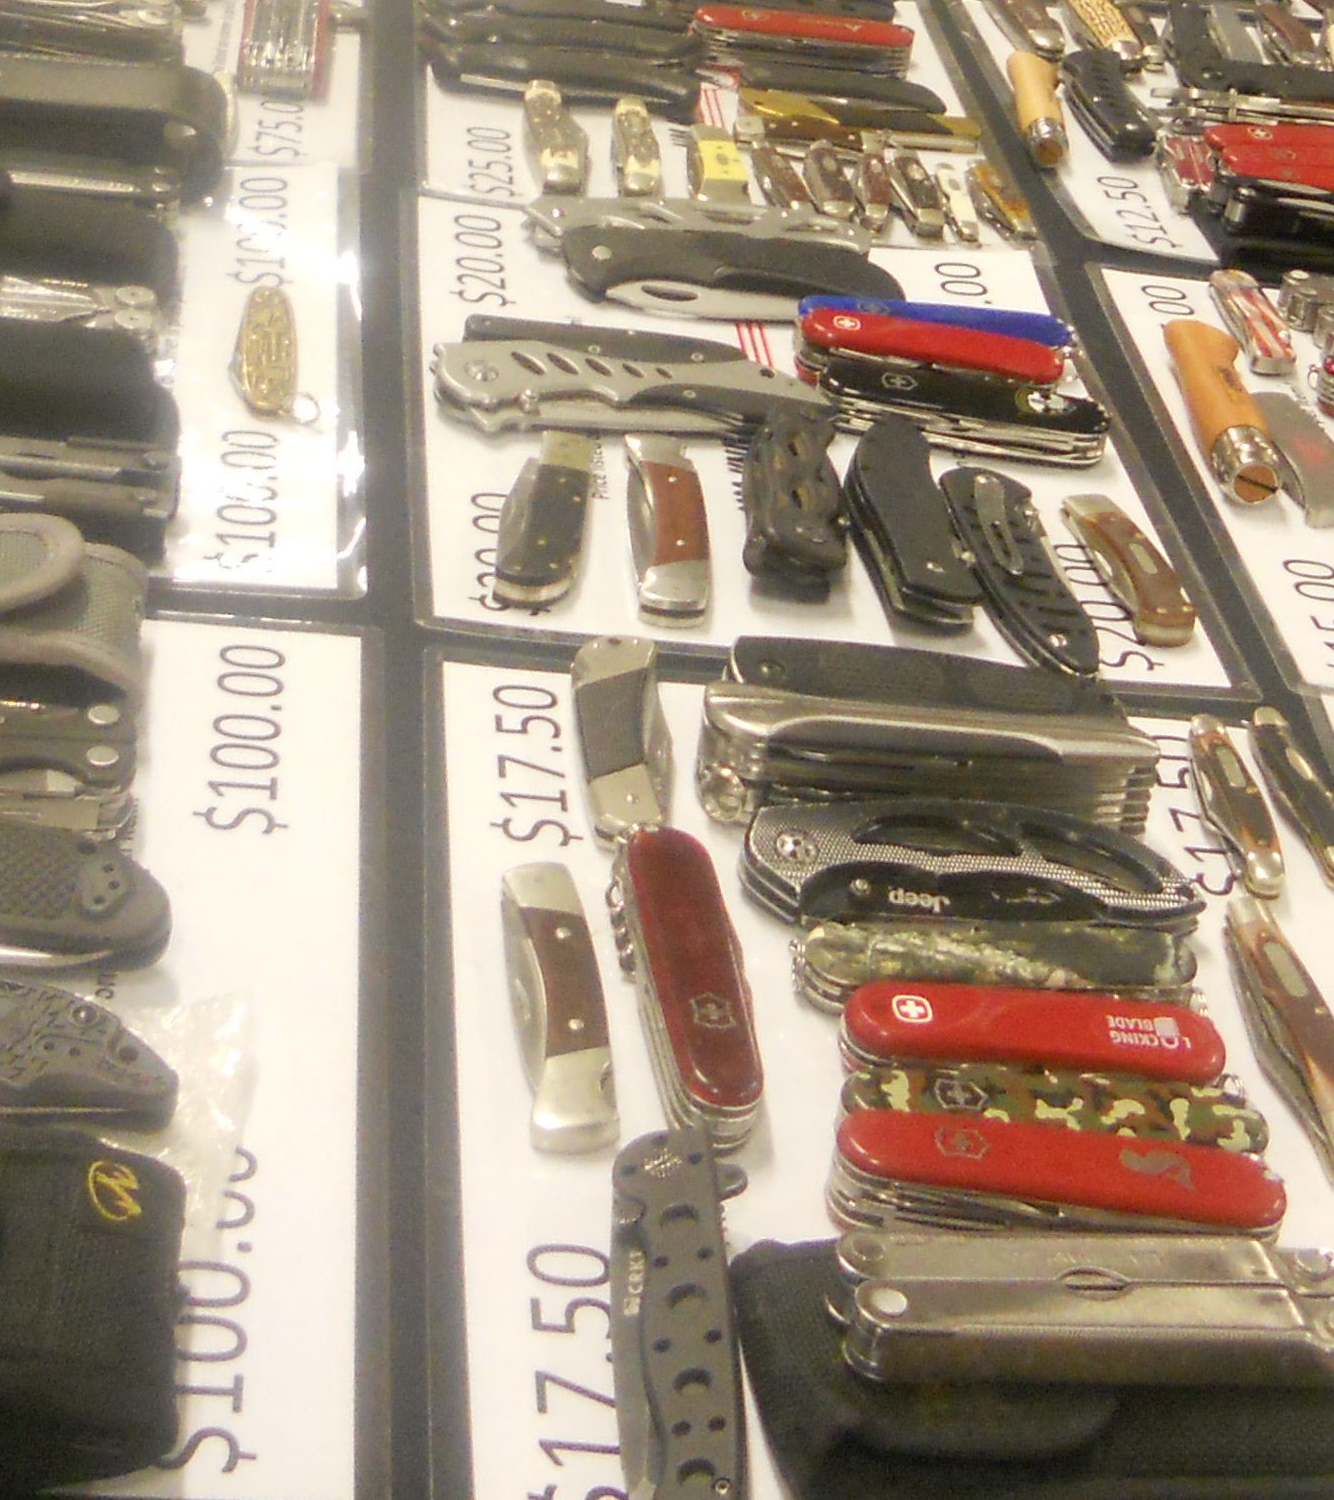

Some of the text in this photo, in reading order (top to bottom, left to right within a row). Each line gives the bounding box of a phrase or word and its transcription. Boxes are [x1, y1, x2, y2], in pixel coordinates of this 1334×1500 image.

[464, 126, 521, 197] $25.00
[1097, 176, 1183, 248] $12.50
[450, 214, 516, 307] $20.00
[193, 644, 289, 835] $100.00
[490, 684, 584, 847] $17.50
[888, 886, 950, 912] Jeep
[1107, 1014, 1154, 1031] BLADE
[526, 1243, 630, 1500] 17.50
